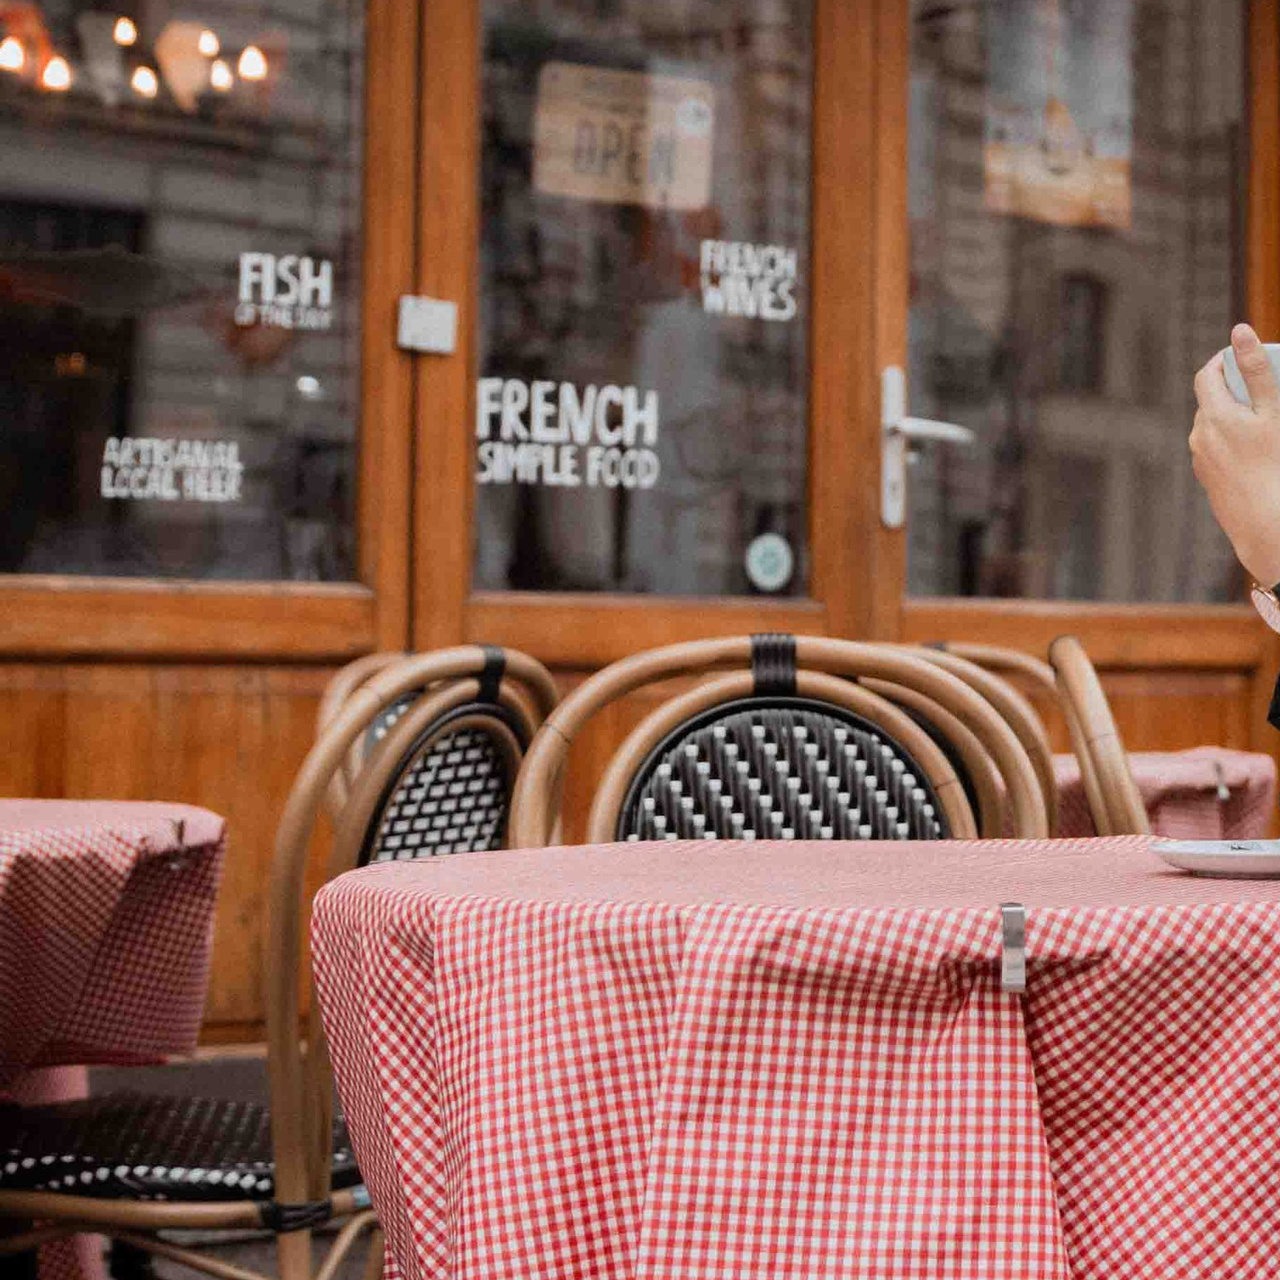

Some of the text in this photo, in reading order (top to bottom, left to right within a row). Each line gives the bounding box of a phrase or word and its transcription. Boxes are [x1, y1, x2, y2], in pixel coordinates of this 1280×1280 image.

[239, 252, 333, 307] FISH
[476, 377, 659, 446] FRENCH
[101, 466, 180, 499] LOCAL
[476, 441, 661, 489] SIMPLE FOOD
